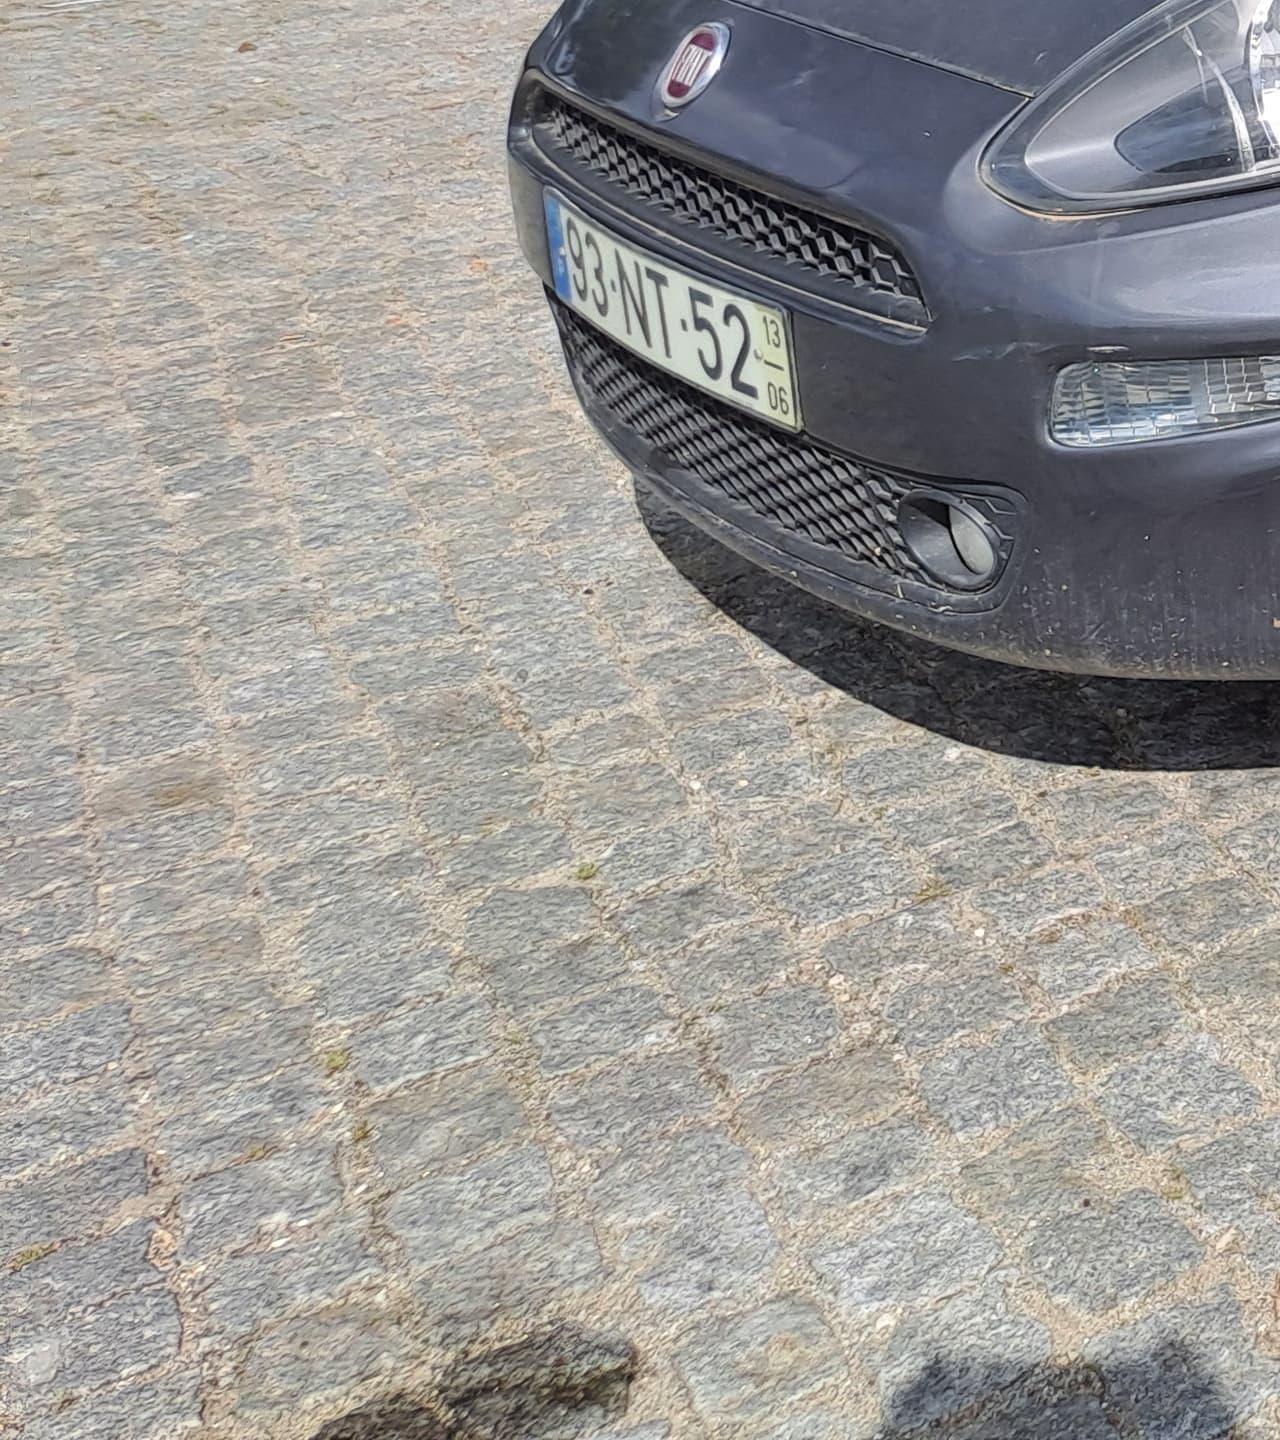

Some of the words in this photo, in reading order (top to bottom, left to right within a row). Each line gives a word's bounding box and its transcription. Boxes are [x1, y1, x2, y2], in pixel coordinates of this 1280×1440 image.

[671, 43, 712, 88] FIAT
[566, 217, 758, 400] 93·NT·52
[762, 315, 782, 349] 13
[768, 381, 790, 416] 06
